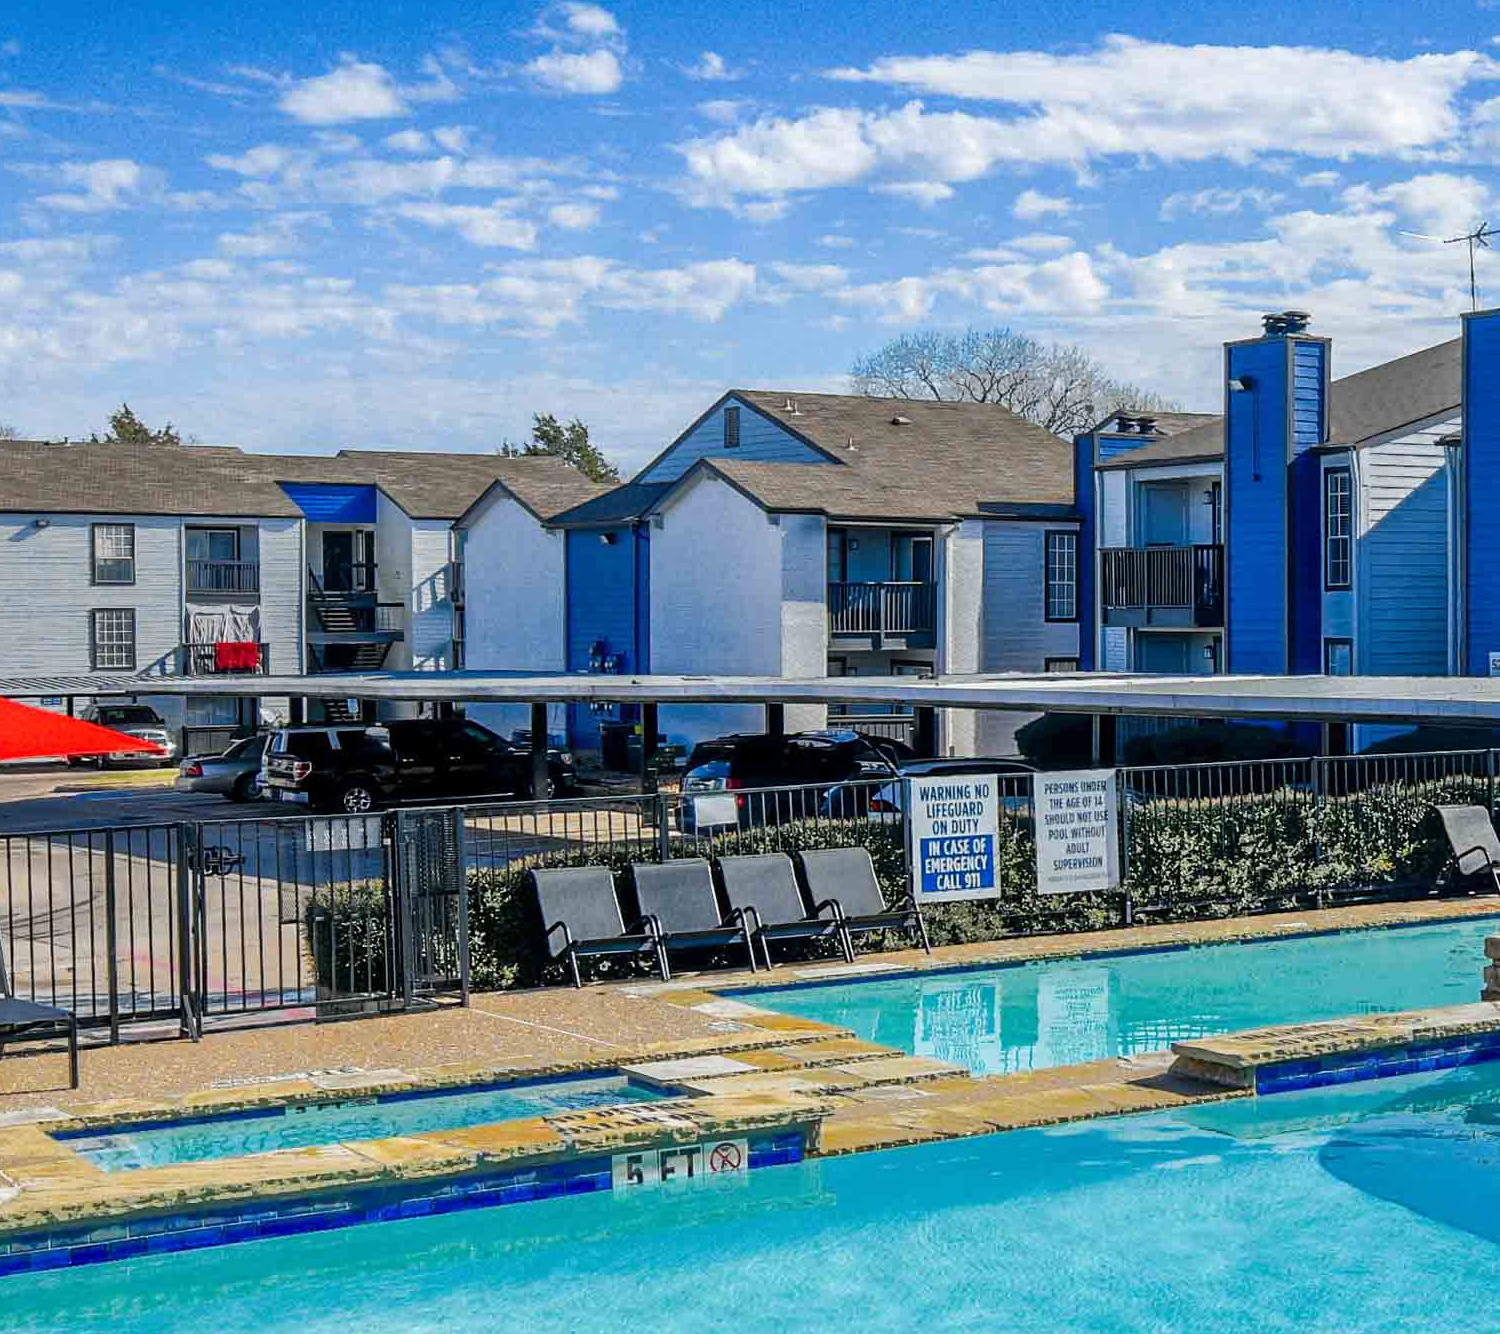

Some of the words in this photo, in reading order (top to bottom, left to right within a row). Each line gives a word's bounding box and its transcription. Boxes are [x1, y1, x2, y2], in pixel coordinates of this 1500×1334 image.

[919, 784, 971, 801] WARNING
[974, 783, 989, 798] NO
[1044, 783, 1078, 794] PERSONS
[1080, 781, 1107, 793] UNDER
[926, 802, 984, 818] LIFEGUARD
[1050, 798, 1063, 809] THE
[1066, 797, 1080, 808] AGE
[1082, 796, 1092, 807] OF
[1044, 813, 1075, 825] SHOULD
[1077, 812, 1092, 823] NOT
[1094, 811, 1108, 821] USE
[932, 821, 948, 835] ON
[951, 818, 979, 834] DUTY
[1048, 829, 1068, 840] POOL
[1071, 826, 1105, 838] WITHOUT
[928, 841, 941, 857] IN
[944, 839, 970, 856] CASE
[972, 837, 987, 854] OF
[1066, 843, 1089, 854] ADULT
[925, 855, 988, 874] EMERGENCY
[1053, 857, 1103, 870] SUPERVISION
[935, 874, 962, 891] CALL
[964, 872, 981, 888] 911
[627, 1155, 643, 1185] 5
[661, 1147, 701, 1181] FT
